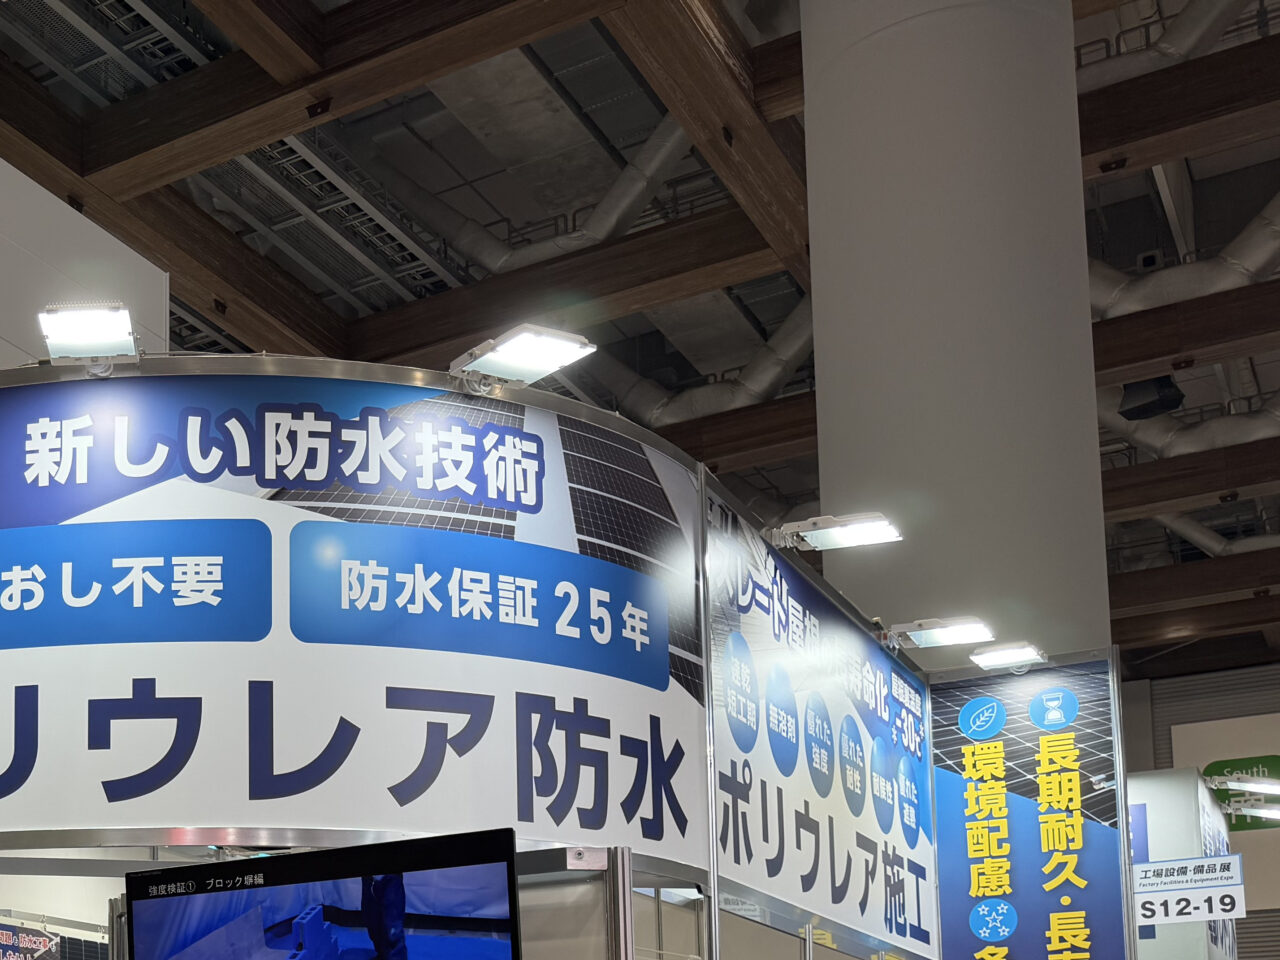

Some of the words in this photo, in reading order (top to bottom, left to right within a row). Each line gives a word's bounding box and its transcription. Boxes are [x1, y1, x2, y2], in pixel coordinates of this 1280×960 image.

[23, 412, 544, 508] 新しい防水技術
[718, 757, 932, 947] ポリウレア施工
[960, 741, 1014, 899] 環境配慮
[1139, 879, 1159, 888] Factory
[1160, 877, 1185, 886] Facilities
[1189, 875, 1220, 885] Equipment
[1140, 893, 1236, 919] S12-19
